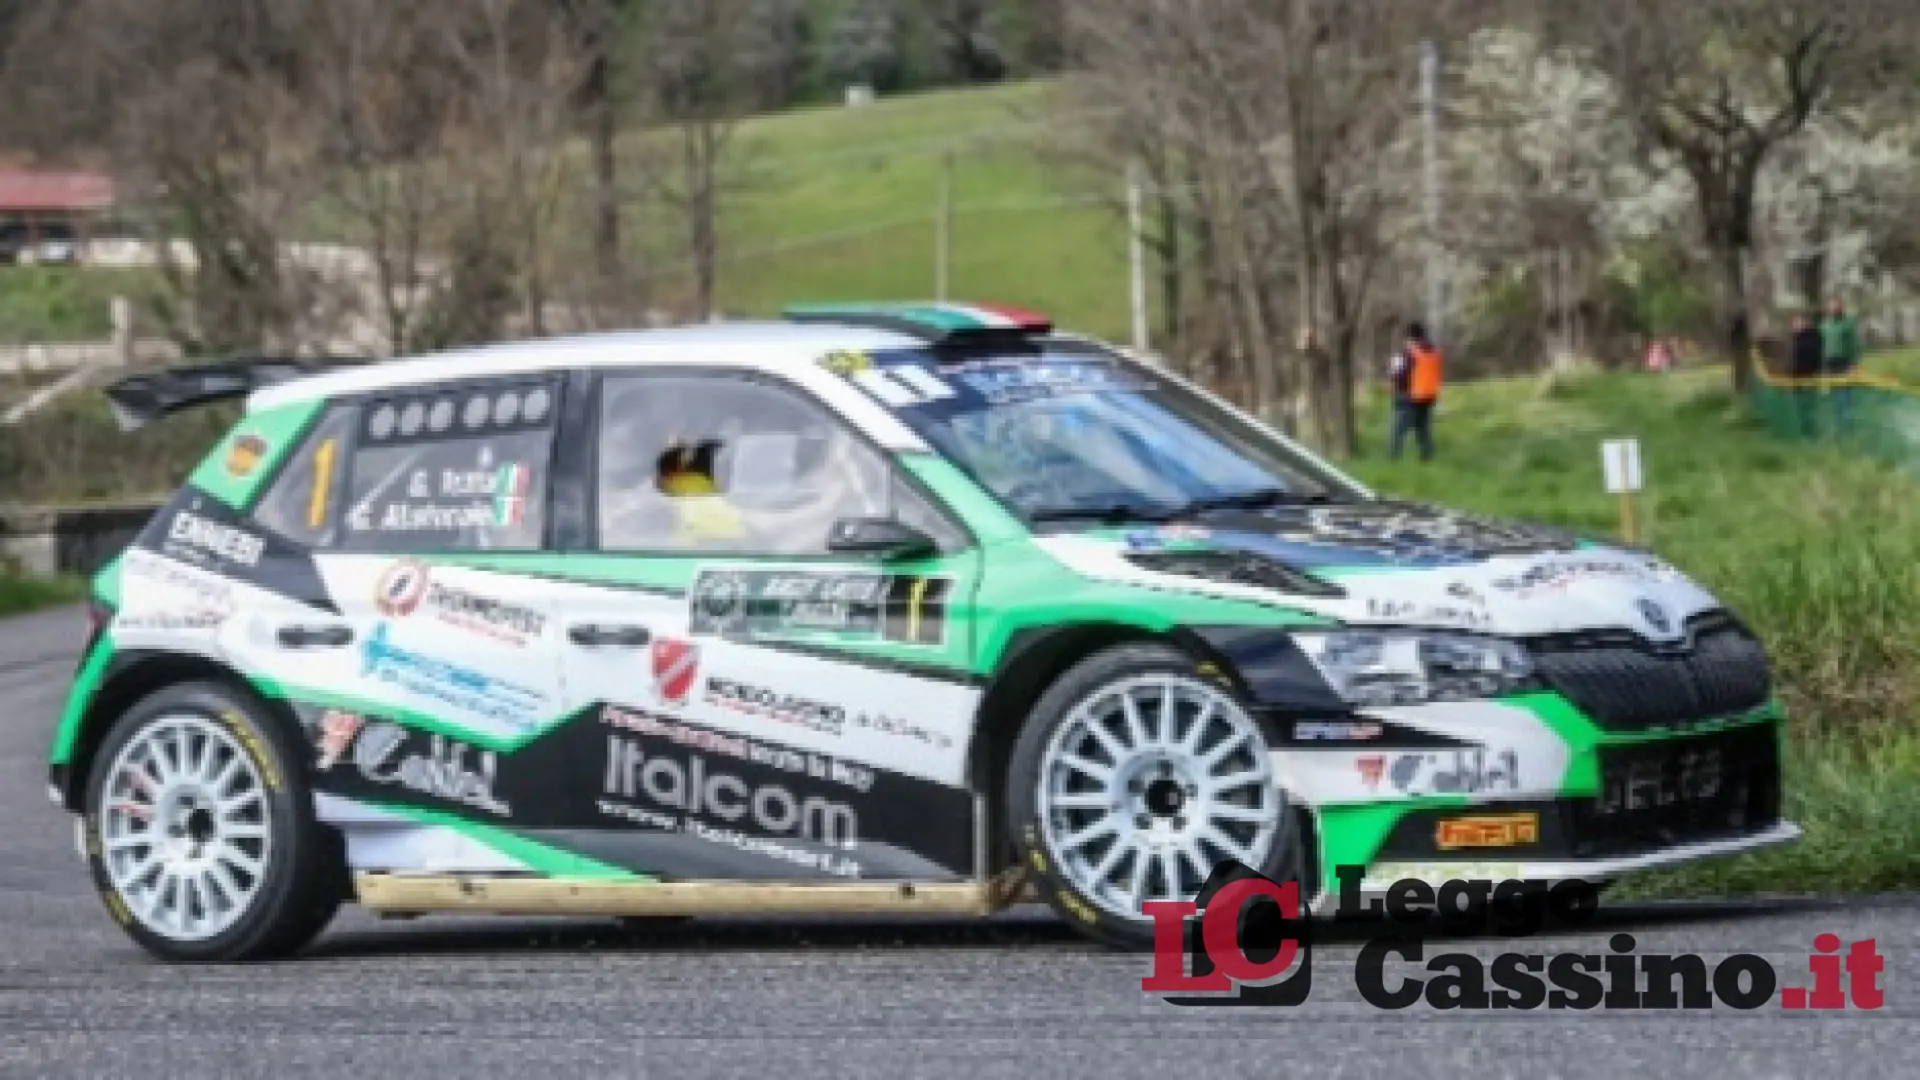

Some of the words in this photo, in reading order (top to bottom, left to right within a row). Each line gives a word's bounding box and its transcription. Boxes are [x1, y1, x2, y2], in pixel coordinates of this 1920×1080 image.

[307, 438, 337, 529] 1
[908, 576, 930, 643] 1
[604, 733, 859, 851] Italcom
